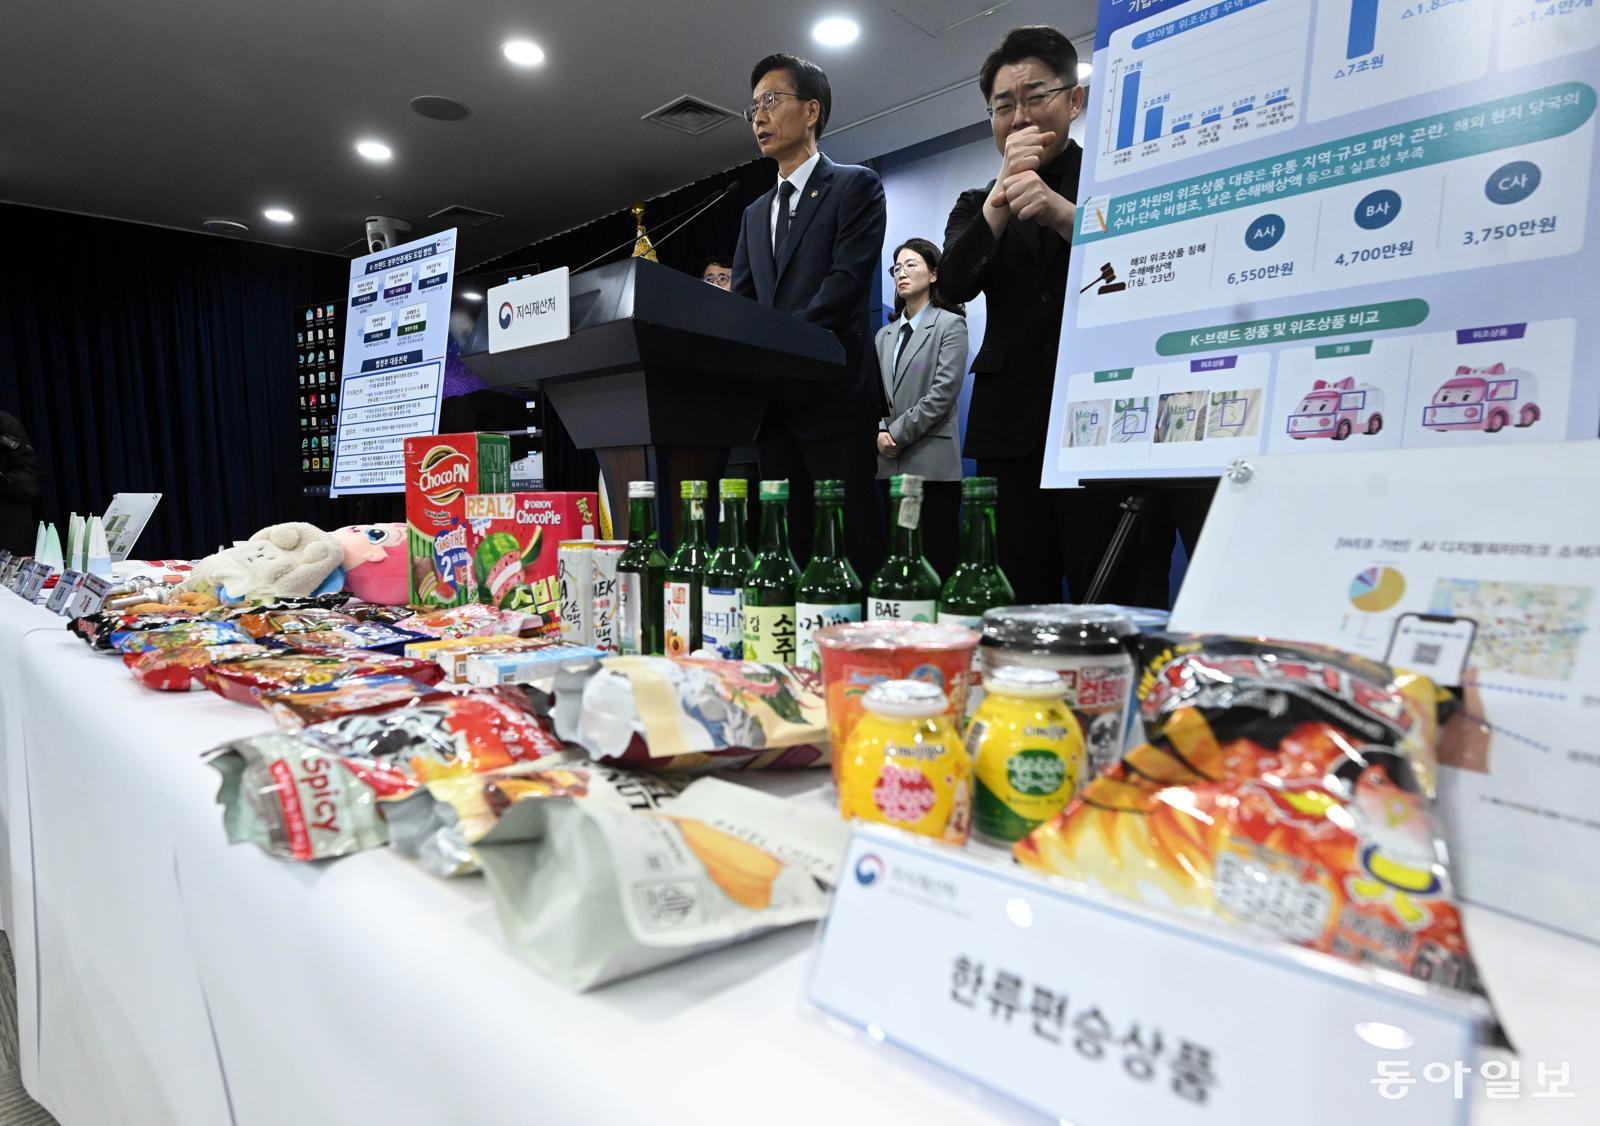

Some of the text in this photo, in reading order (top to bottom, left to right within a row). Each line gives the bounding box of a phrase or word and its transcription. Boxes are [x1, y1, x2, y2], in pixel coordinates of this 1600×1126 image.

[1146, 23, 1175, 43] 분야별
[1178, 7, 1220, 31] 위조상품
[1124, 60, 1143, 73] 7조원
[1143, 93, 1170, 109] 2.8조원
[1115, 198, 1137, 215] 기업
[1139, 189, 1174, 210] 차원의
[1177, 177, 1226, 201] 위조상품
[1229, 167, 1267, 186] 대응은
[1271, 157, 1298, 178] 유통
[1371, 132, 1404, 152] 파악
[1409, 123, 1448, 144] 곤란,
[1453, 115, 1485, 133] 해외
[1490, 105, 1523, 126] 현지
[1528, 91, 1581, 115] 당국의
[1164, 200, 1202, 218] 비협조,
[1206, 193, 1231, 211] 낮은
[1235, 175, 1303, 203] 손해배상액
[1307, 167, 1345, 184] 등으로
[1350, 153, 1391, 176] 실효성
[1395, 145, 1425, 164] 부족
[1497, 172, 1529, 192] C사
[1365, 200, 1391, 218] B사
[1253, 224, 1276, 240] A사
[1462, 215, 1557, 246] 3,750만원
[1130, 242, 1207, 267] 해외 위조상품 침해
[1334, 240, 1414, 268] 4,700만원
[1128, 260, 1172, 278] 손해배상액
[1227, 261, 1294, 285] 6,550만원
[1127, 278, 1147, 289] (1심,
[516, 296, 556, 319] 지식재산처
[1190, 309, 1380, 347] K-브랜드 정품 및 위조상품 비교
[375, 354, 408, 369] 범정부 대응전략
[419, 463, 470, 492] ChocoPN
[465, 496, 514, 518] REAL?
[516, 510, 561, 525] ChocoPie
[875, 601, 901, 617] BAE
[771, 613, 796, 663] 소주
[300, 757, 341, 834] Spicy
[949, 953, 1218, 1105] 한류편승상품
